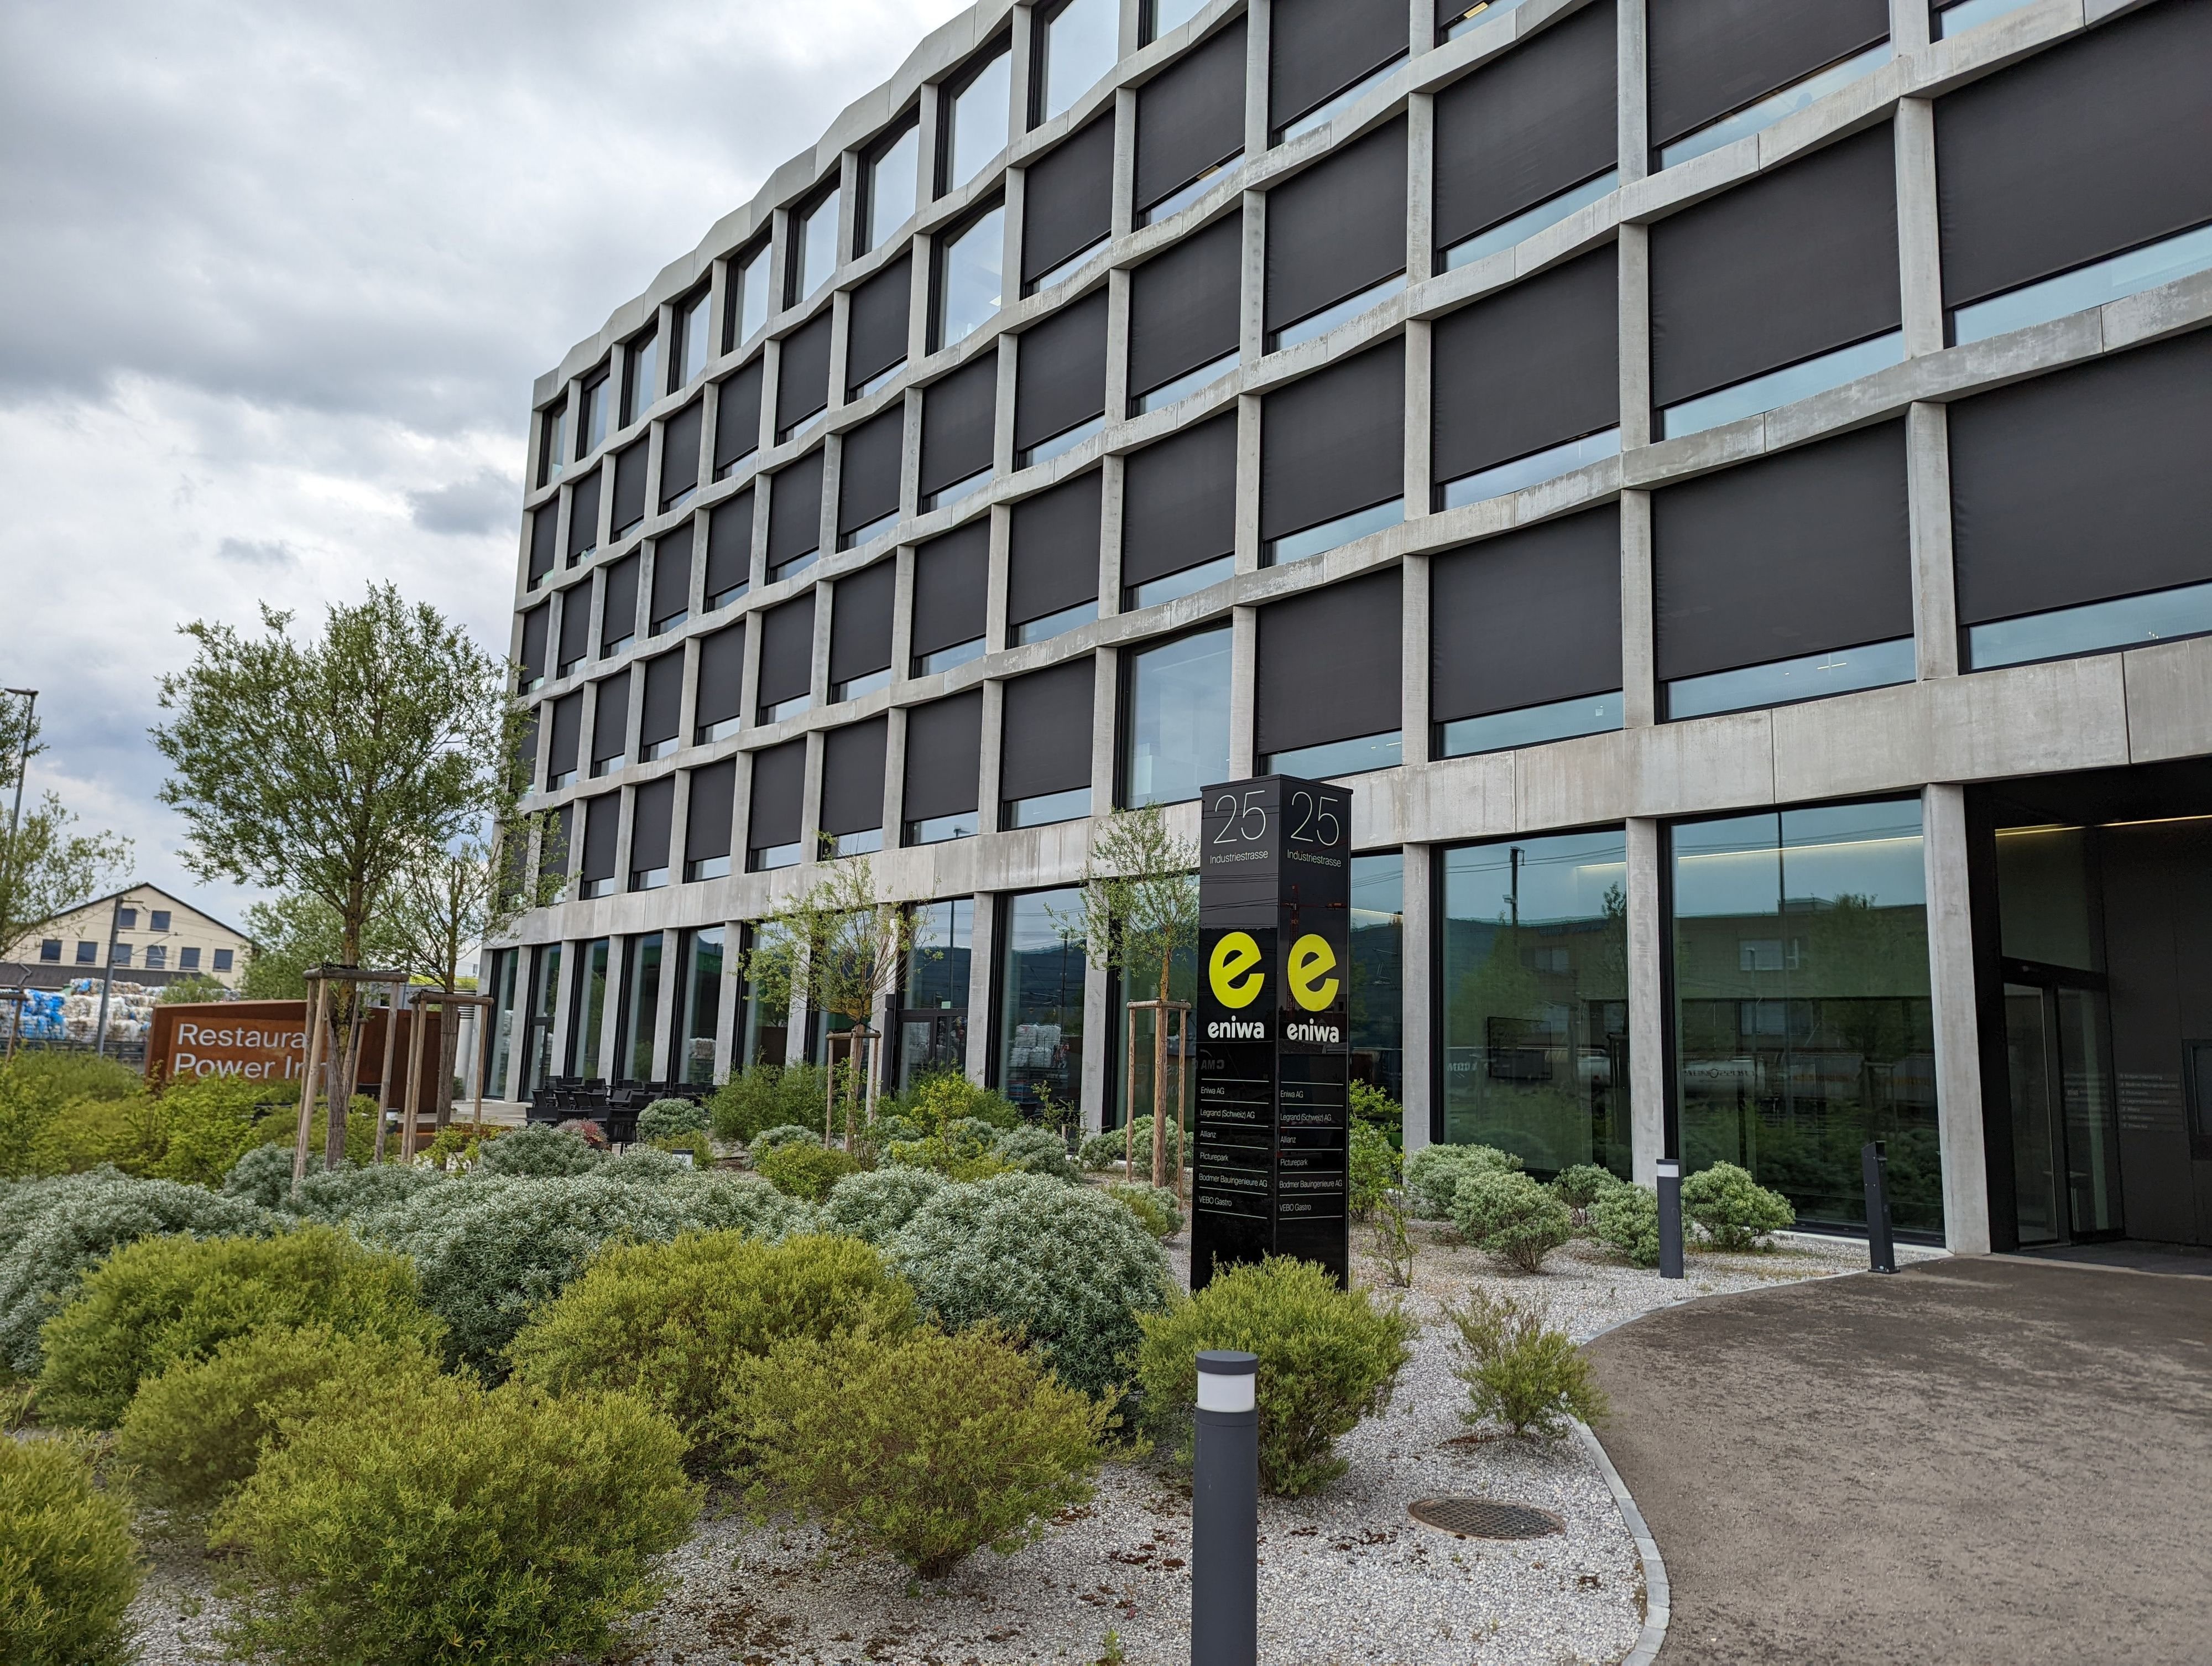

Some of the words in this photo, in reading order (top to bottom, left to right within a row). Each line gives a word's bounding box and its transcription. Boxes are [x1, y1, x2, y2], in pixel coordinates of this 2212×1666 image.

[1213, 790, 1266, 845] 25
[1290, 791, 1339, 846] 25
[1210, 850, 1269, 865] Industriestrasse
[1287, 849, 1342, 868] Industriestrasse
[1207, 1016, 1265, 1039] eniwa
[1287, 1018, 1339, 1043] eniwa
[178, 1023, 306, 1049] Restaura
[174, 1053, 275, 1079] Power
[1201, 1086, 1215, 1095] Eniwa
[1200, 1108, 1221, 1117] Legrand
[1222, 1110, 1246, 1119] (Schweiz)
[1280, 1113, 1300, 1122] Legrand
[1301, 1113, 1324, 1122] (Schweiz)
[1200, 1130, 1217, 1138] Allianz
[1200, 1152, 1228, 1162] Picturepark
[1280, 1158, 1308, 1167] Picturepark
[1199, 1173, 1220, 1182] Bodmer
[1220, 1175, 1258, 1186] Bauingenieure
[1259, 1179, 1267, 1188] AG
[1279, 1180, 1300, 1189] Bodmer
[1300, 1180, 1334, 1189] Bauingenieure
[1198, 1195, 1214, 1204] VEBO
[1214, 1198, 1232, 1206] Gastro
[1279, 1204, 1294, 1212] VEBO
[1295, 1203, 1312, 1211] Gastro
